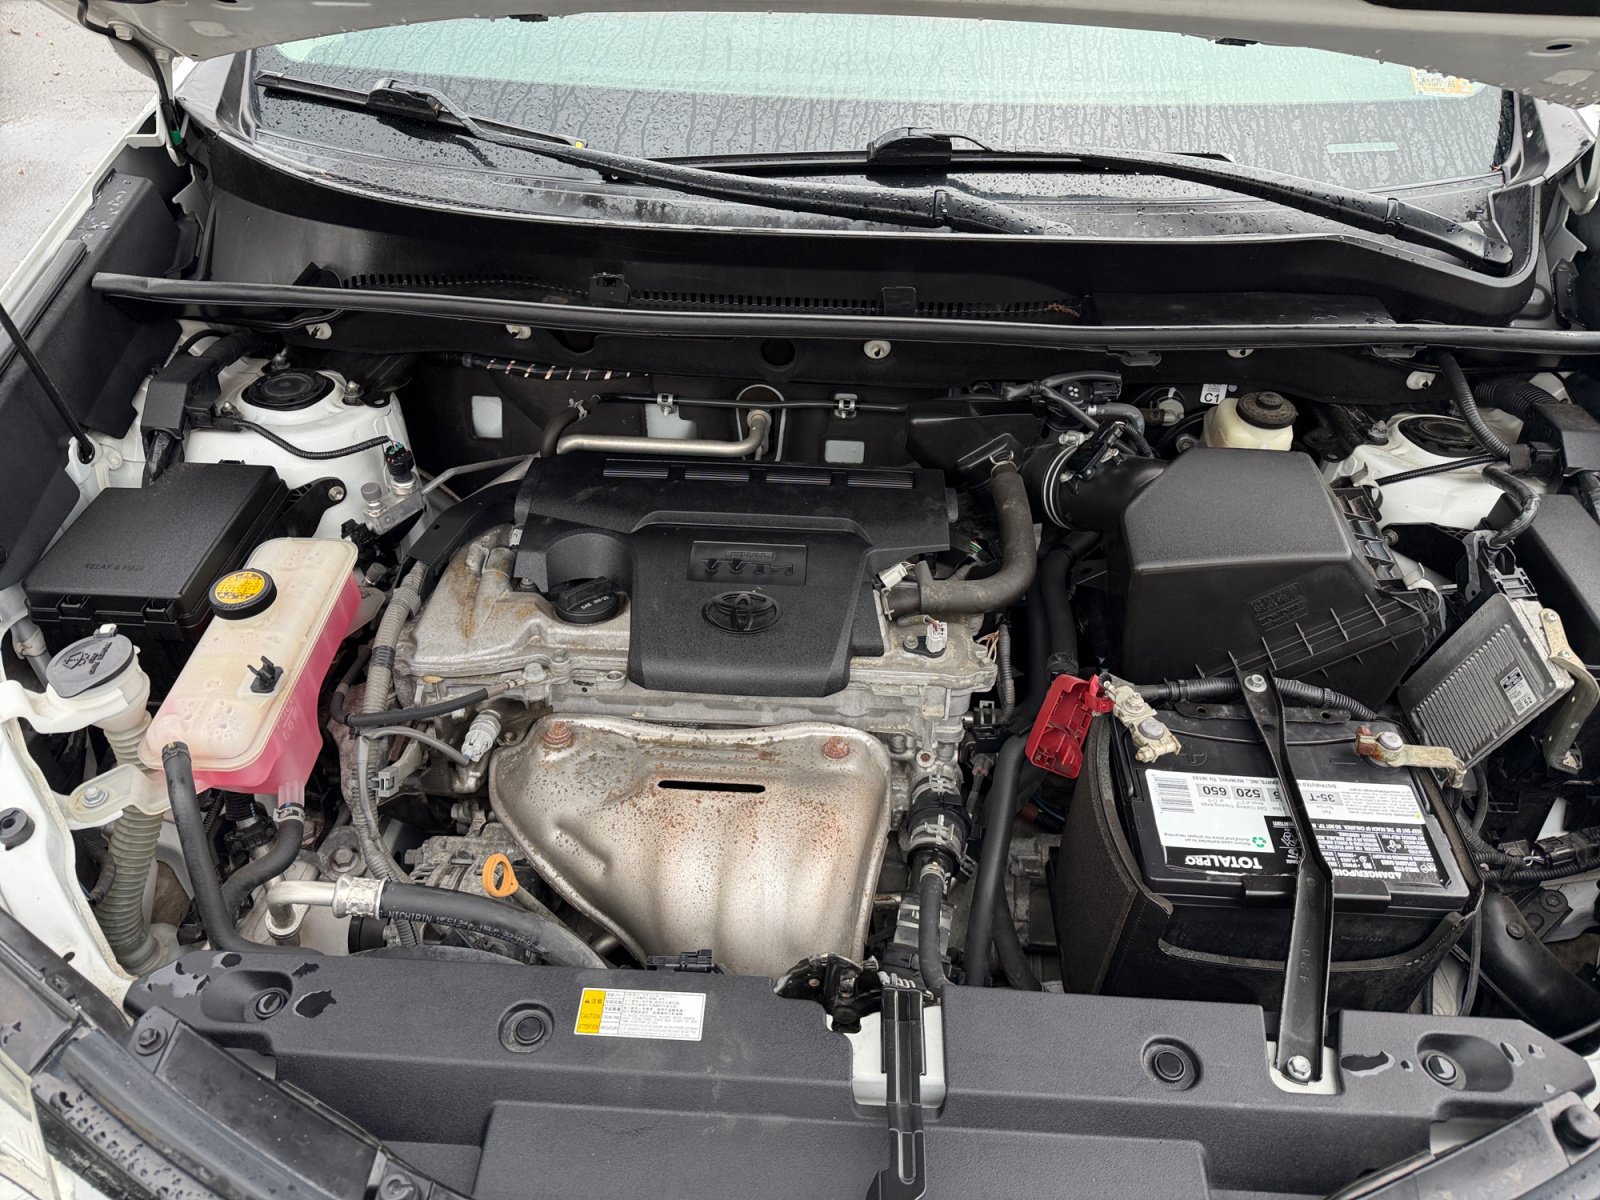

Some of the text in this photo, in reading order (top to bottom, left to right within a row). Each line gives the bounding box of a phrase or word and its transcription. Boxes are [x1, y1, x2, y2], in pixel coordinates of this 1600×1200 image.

[1204, 392, 1220, 403] C1
[1203, 786, 1227, 797] 650
[1236, 788, 1261, 799] 520
[1309, 793, 1335, 803] 35-T
[1185, 855, 1264, 870] TOTALPRO
[1333, 868, 1395, 880] DANGER/POIS
